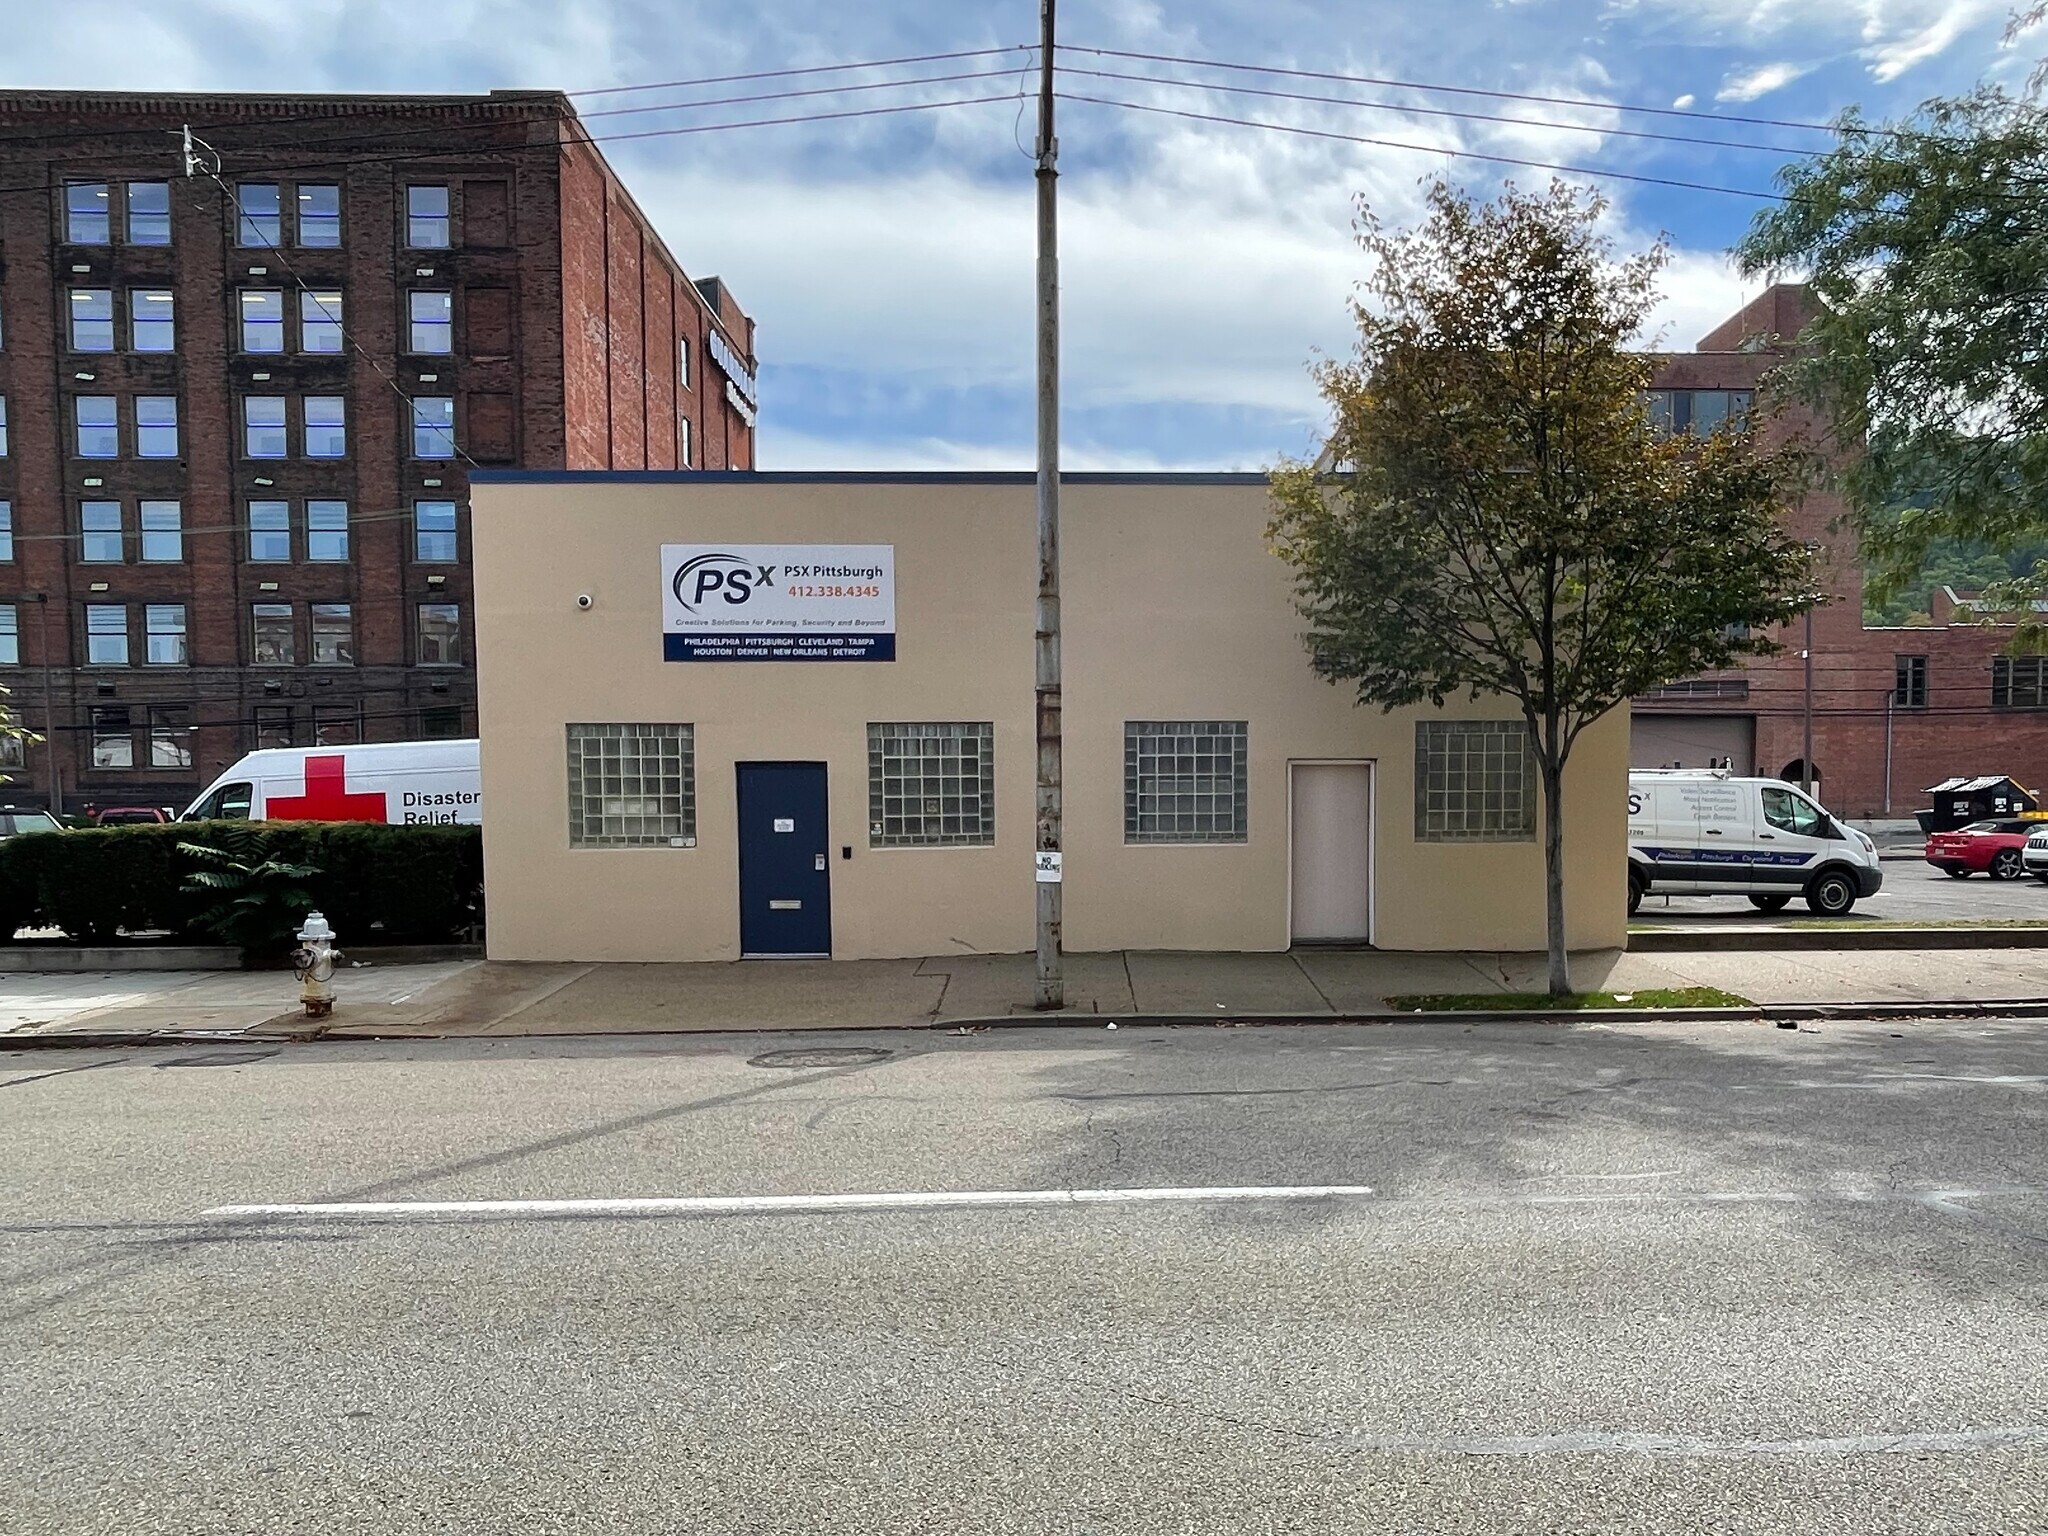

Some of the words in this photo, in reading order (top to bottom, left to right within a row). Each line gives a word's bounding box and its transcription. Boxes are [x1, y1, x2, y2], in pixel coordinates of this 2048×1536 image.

[784, 566, 810, 577] PSX
[813, 565, 883, 579] Pittsburgh
[788, 586, 880, 597] 412.338.4345
[802, 619, 836, 628] Security
[854, 619, 886, 628] Beyond
[684, 638, 740, 646] PHILADELPHIA
[745, 638, 794, 646] PITTSBURGH
[798, 638, 844, 646] CLEVELAND
[848, 638, 875, 646] TAMPA
[693, 648, 732, 656] HOUSTON
[737, 648, 768, 656] DENVER
[773, 648, 791, 656] NEW
[792, 648, 828, 656] ORLEANS
[833, 648, 866, 656] DETROIT
[403, 791, 481, 807] Disaster
[404, 810, 458, 825] Relief
[1701, 853, 1734, 861] Pittsburgh
